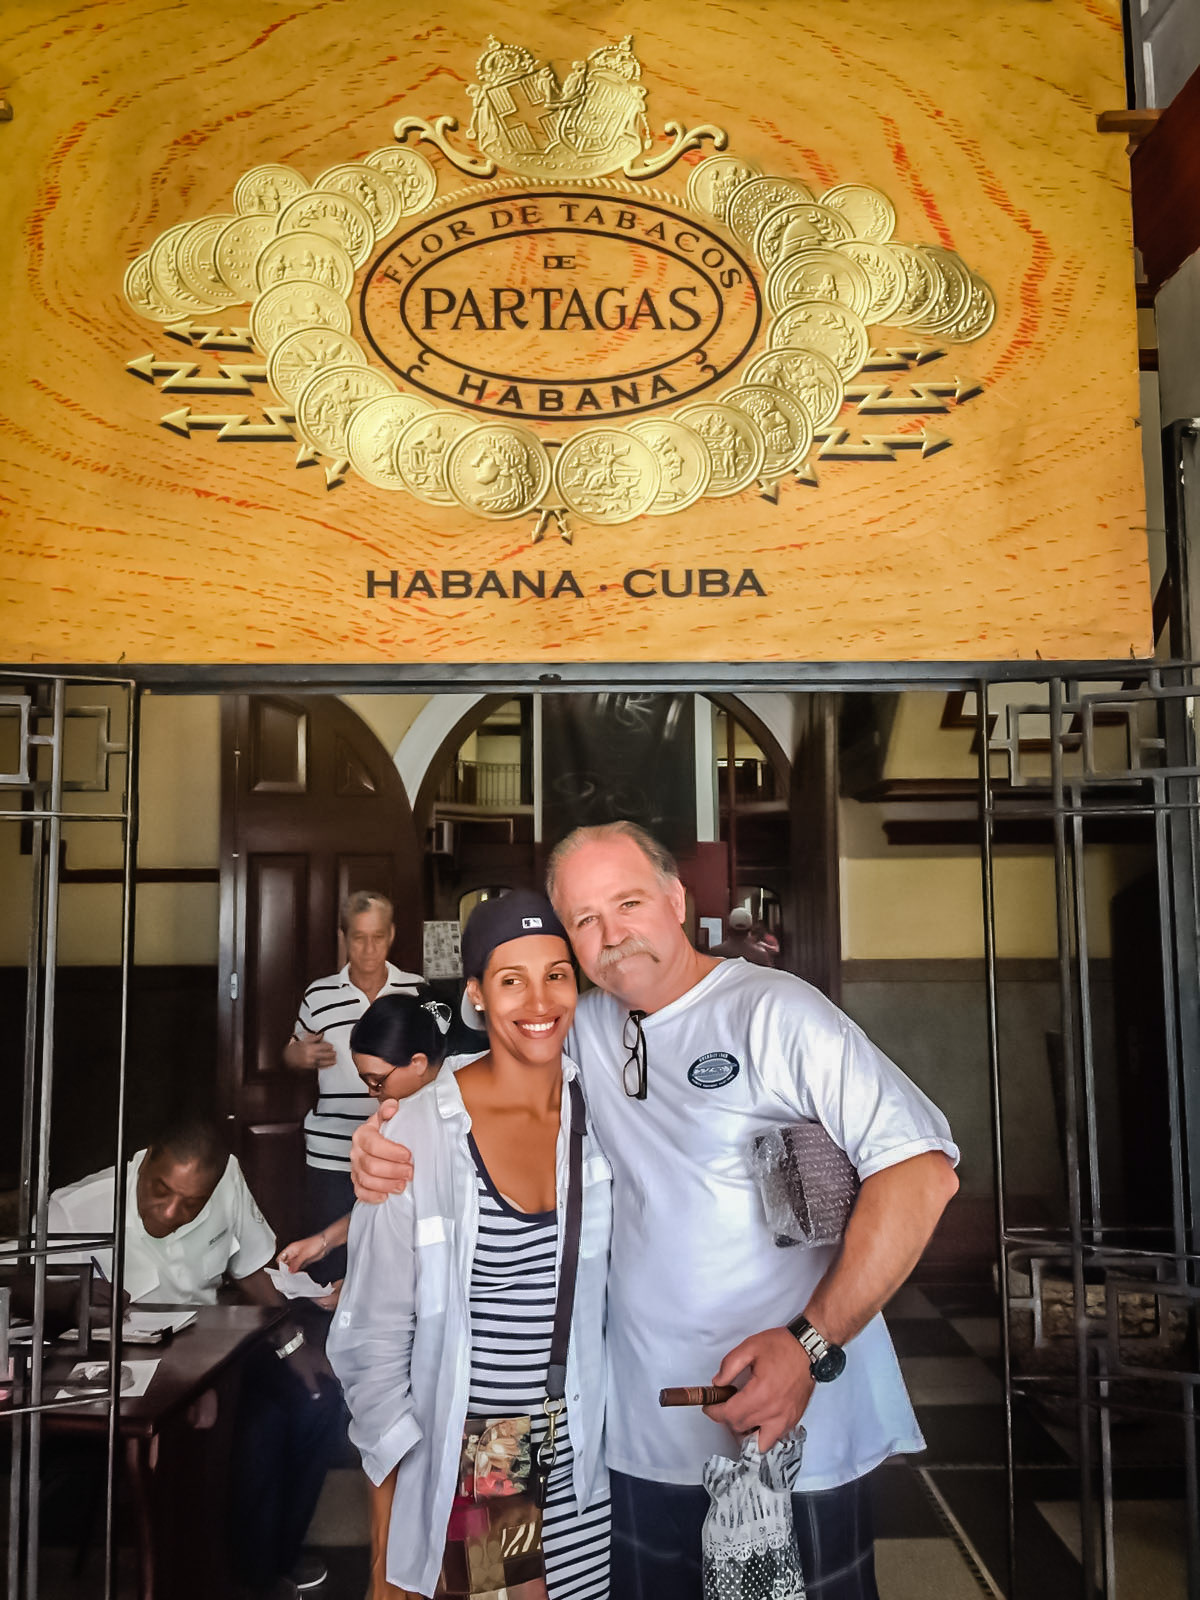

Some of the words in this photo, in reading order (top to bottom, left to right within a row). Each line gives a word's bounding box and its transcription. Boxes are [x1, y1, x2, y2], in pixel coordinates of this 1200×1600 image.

[384, 220, 475, 285] FLOR
[491, 205, 540, 229] DE
[559, 203, 743, 289] TABACOS
[543, 255, 577, 270] DE
[421, 287, 702, 331] PARTAGAS
[457, 373, 678, 412] HABANA
[366, 569, 585, 598] HABANA
[622, 568, 768, 598] CUBA
